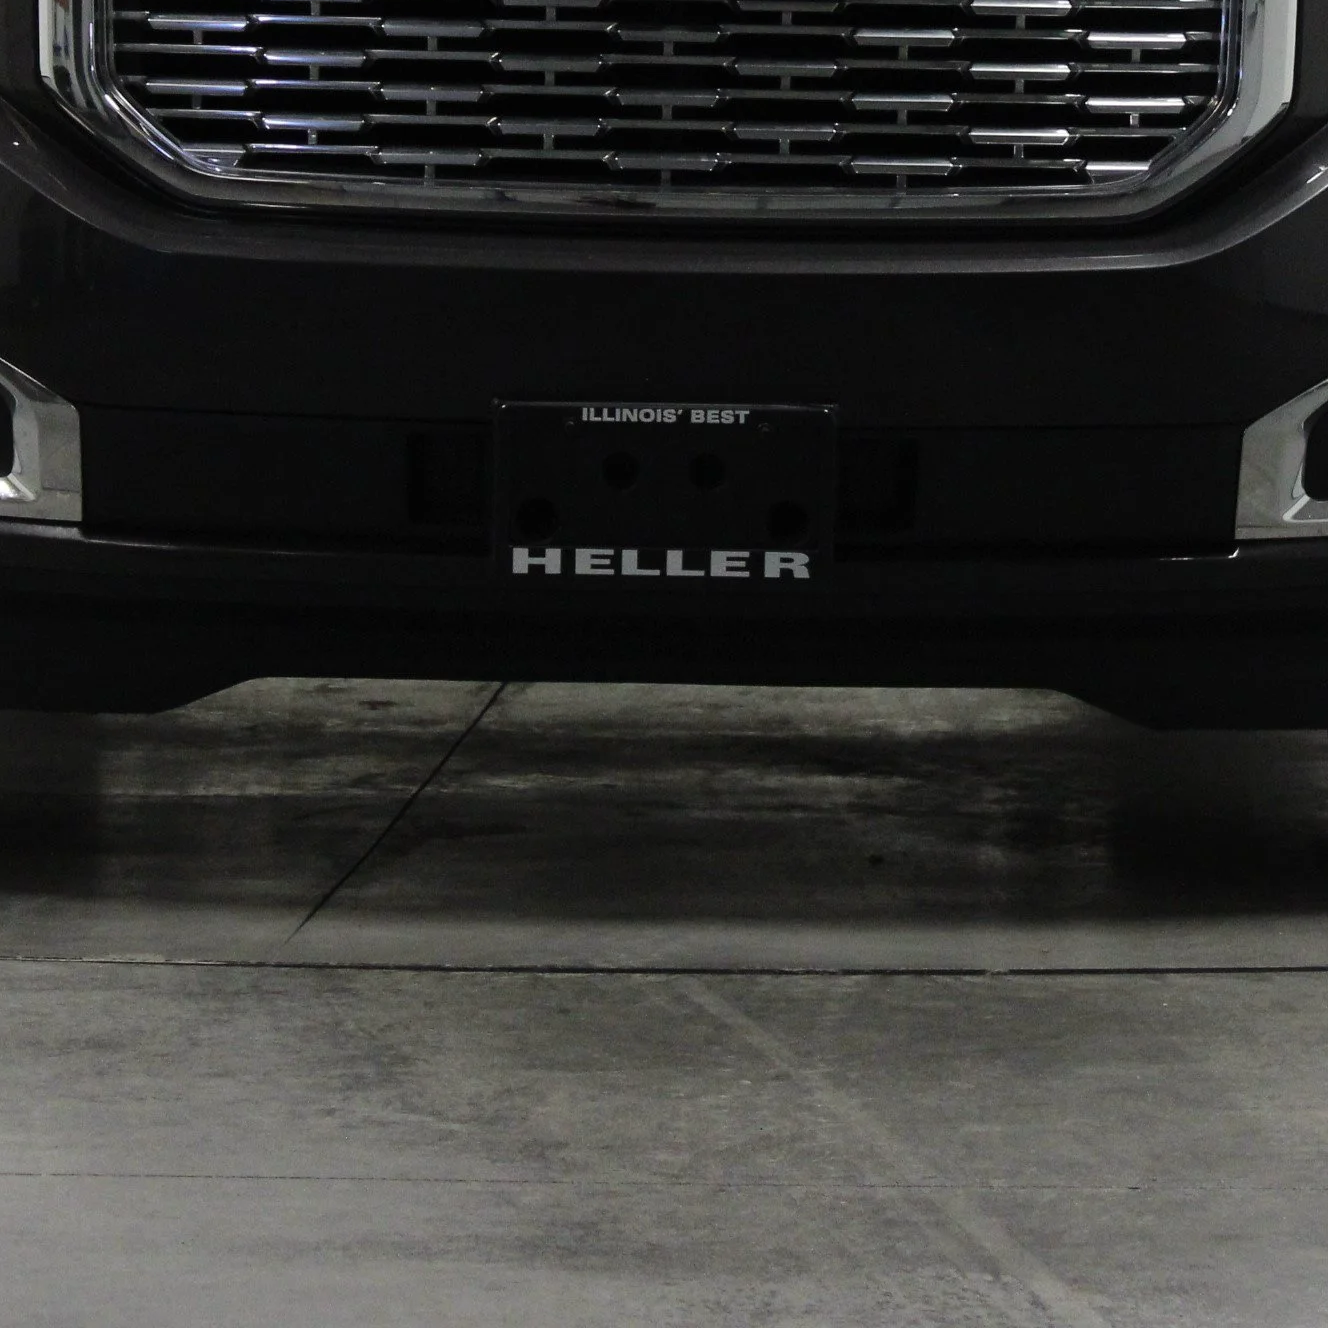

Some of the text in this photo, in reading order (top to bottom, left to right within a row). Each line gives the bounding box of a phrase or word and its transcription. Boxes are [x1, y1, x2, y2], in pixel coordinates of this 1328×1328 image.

[582, 407, 750, 424] ILLINOIS' BEST
[512, 547, 810, 579] HELLER
